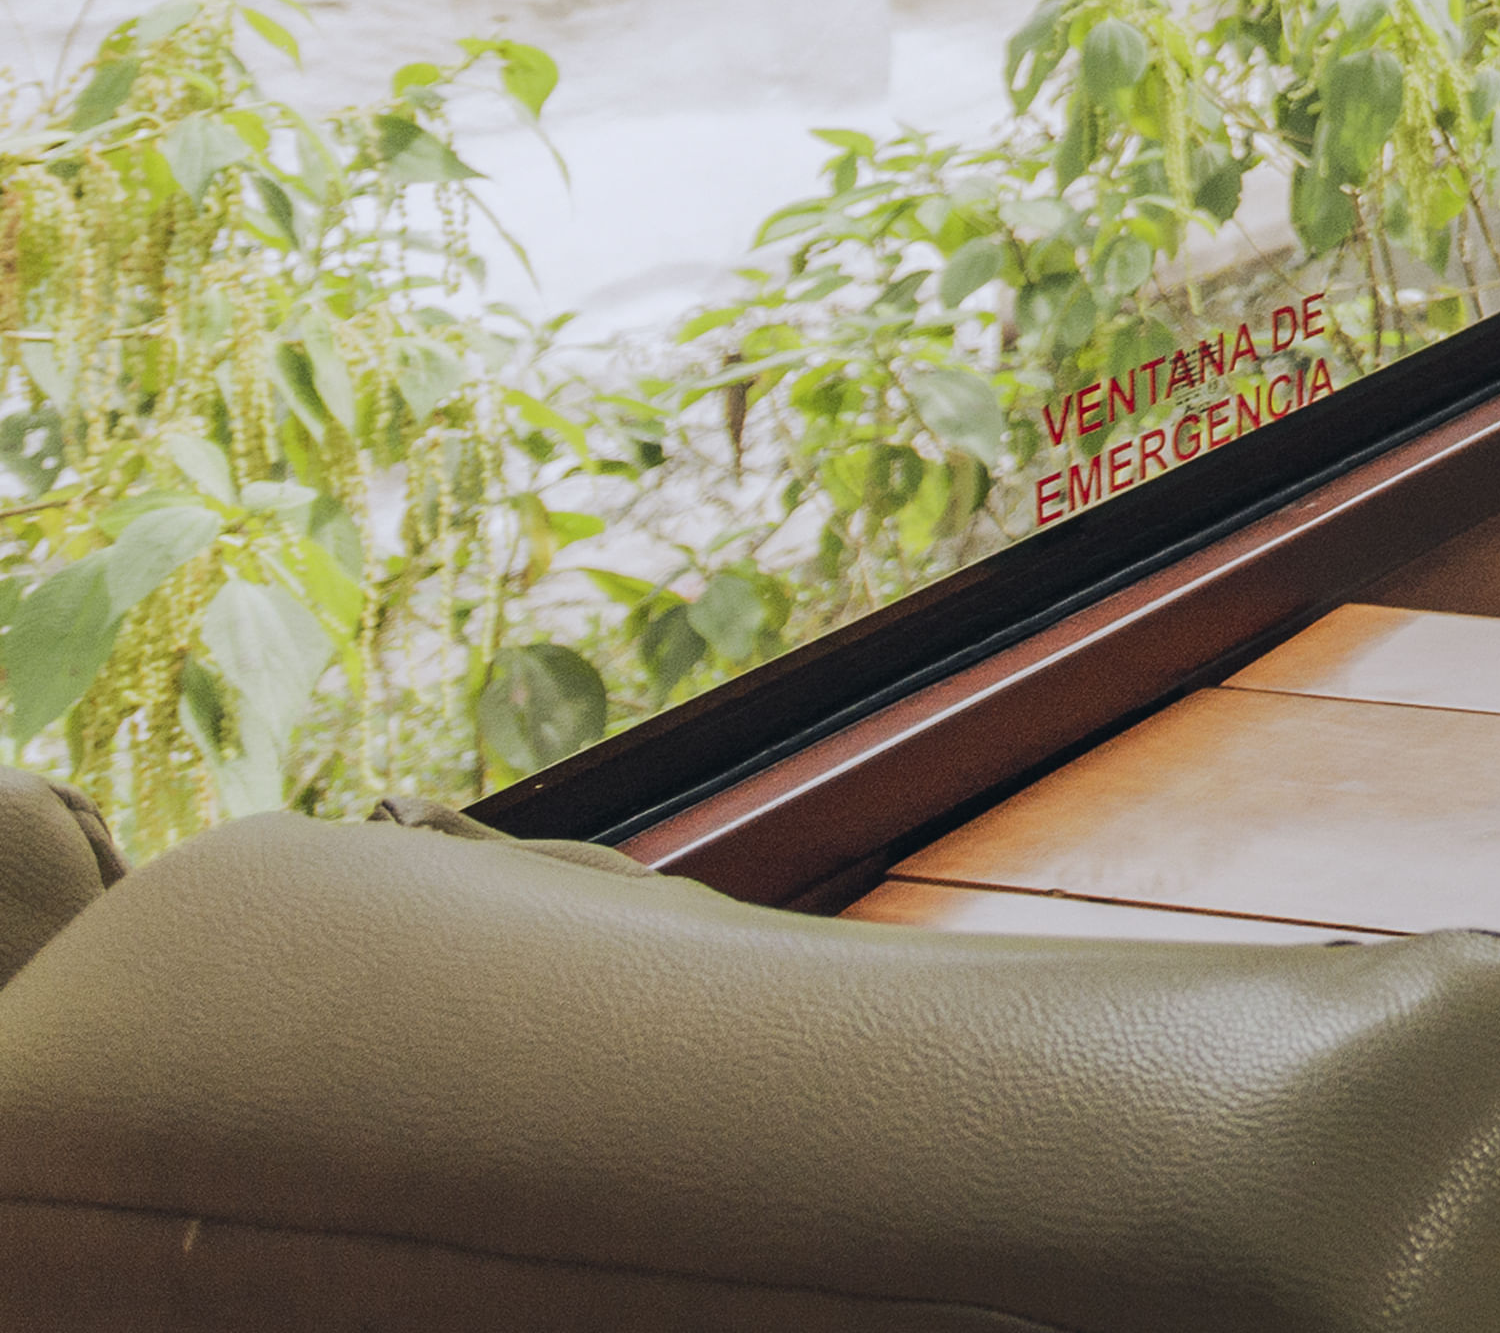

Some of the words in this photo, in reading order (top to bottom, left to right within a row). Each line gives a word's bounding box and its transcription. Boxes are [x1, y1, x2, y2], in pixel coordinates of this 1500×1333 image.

[1036, 357, 1335, 527] EMERGENCIA
[1042, 323, 1260, 447] VENTANA
[1271, 292, 1326, 354] DE
